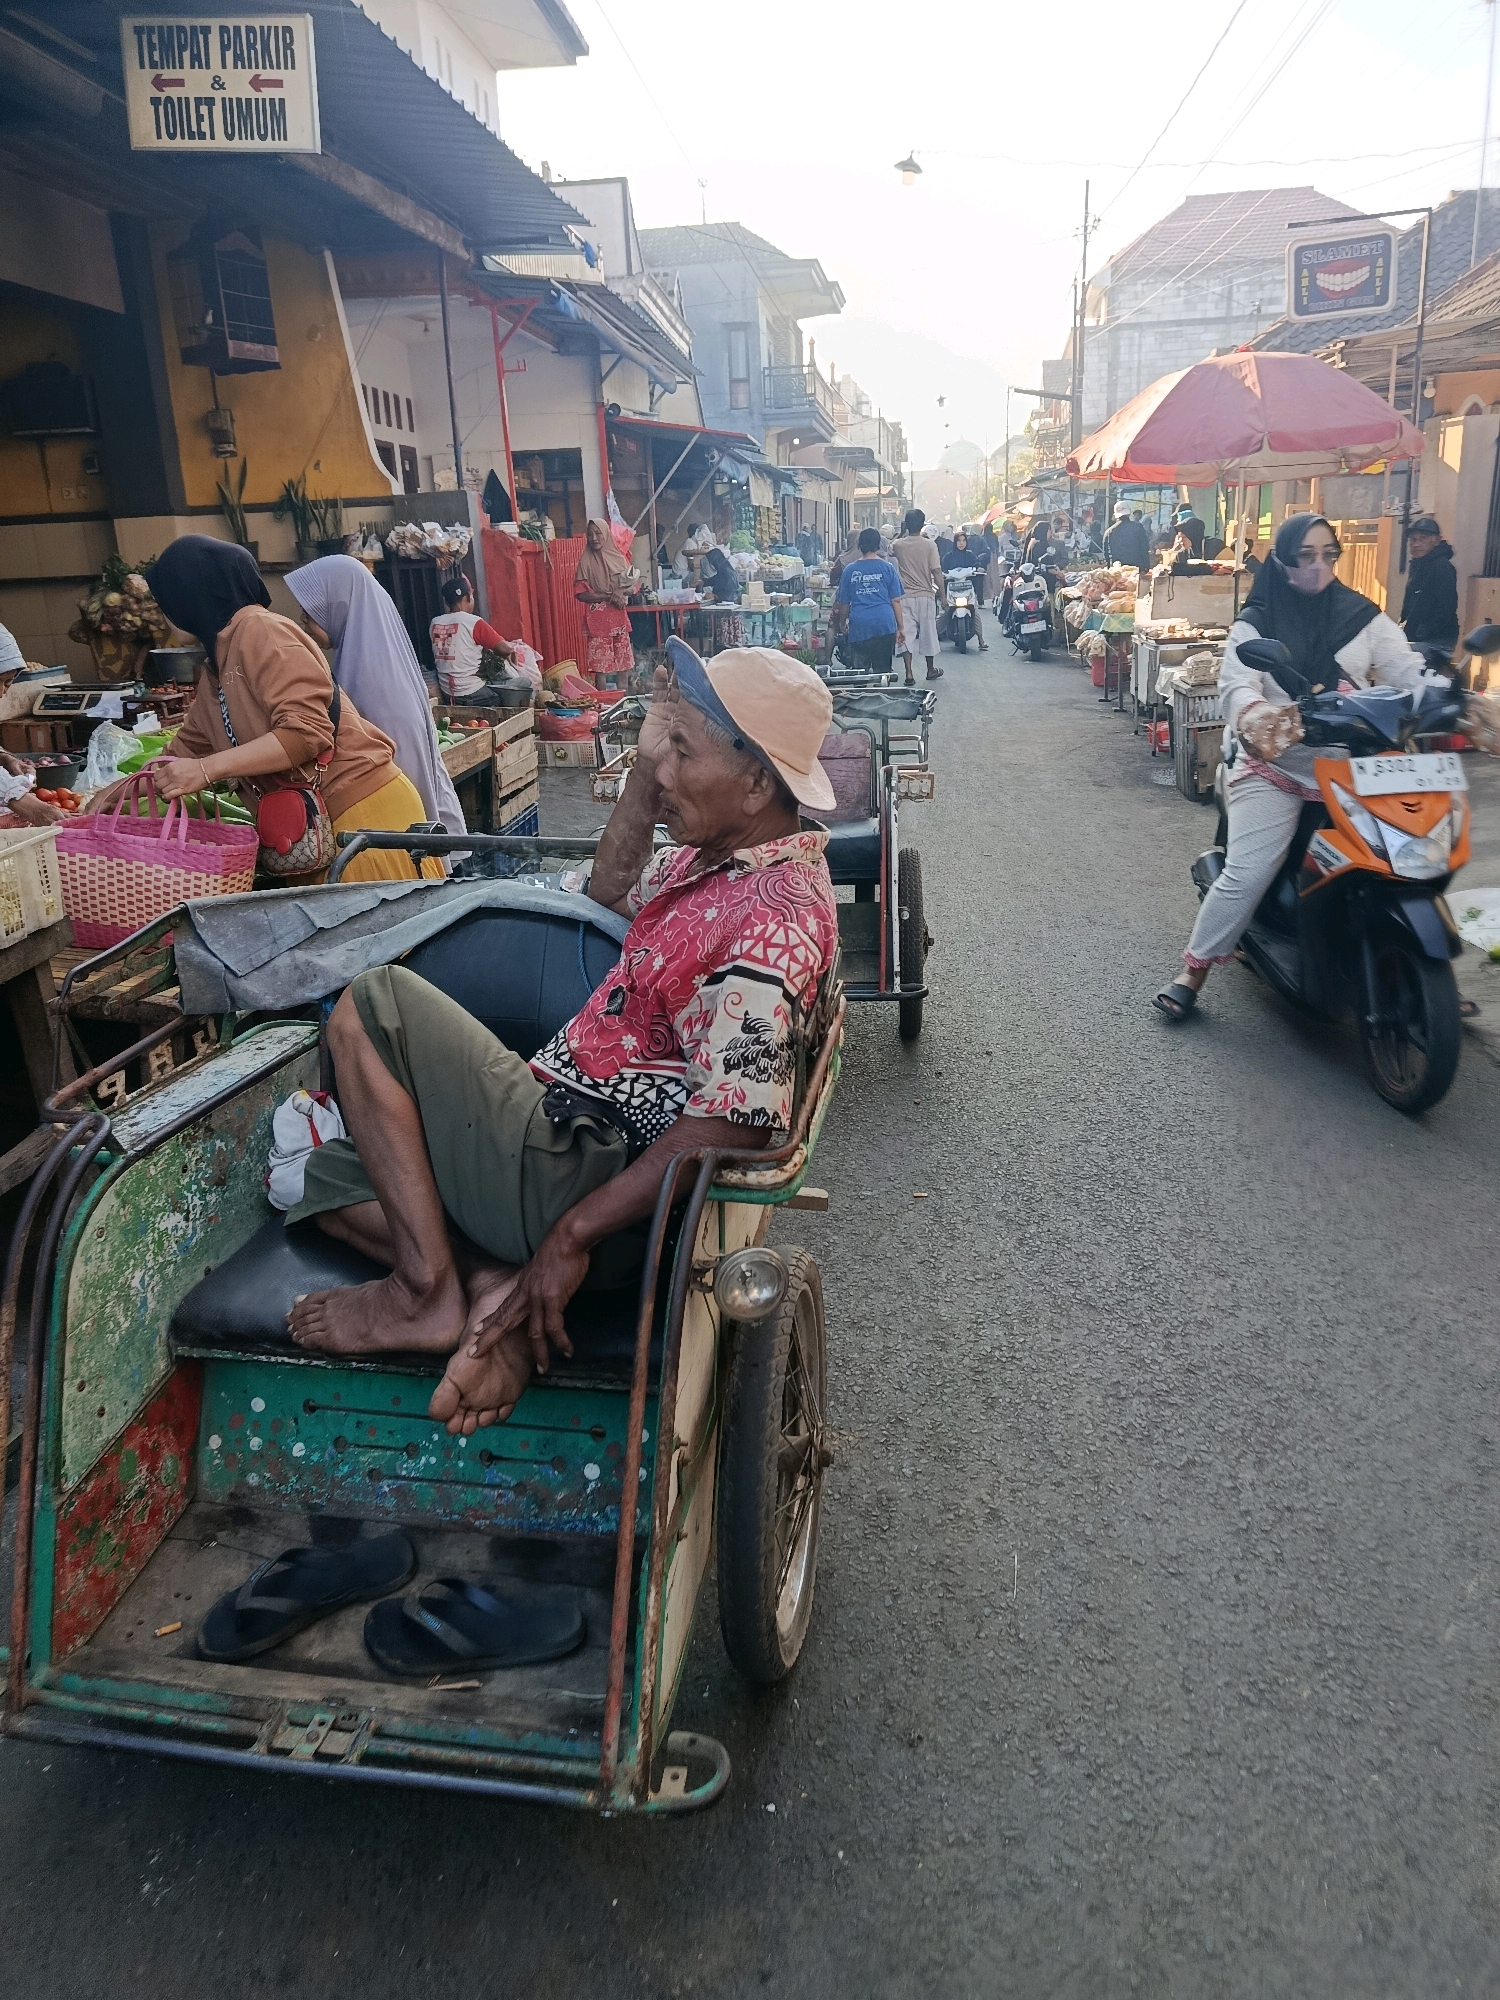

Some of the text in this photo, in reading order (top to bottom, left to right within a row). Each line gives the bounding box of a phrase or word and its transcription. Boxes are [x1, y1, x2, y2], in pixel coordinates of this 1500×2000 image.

[133, 25, 296, 70] TEMPAT PARKIR
[210, 75, 227, 91] &
[149, 96, 288, 142] TOILET UMUM
[1301, 240, 1384, 265] SLAMET
